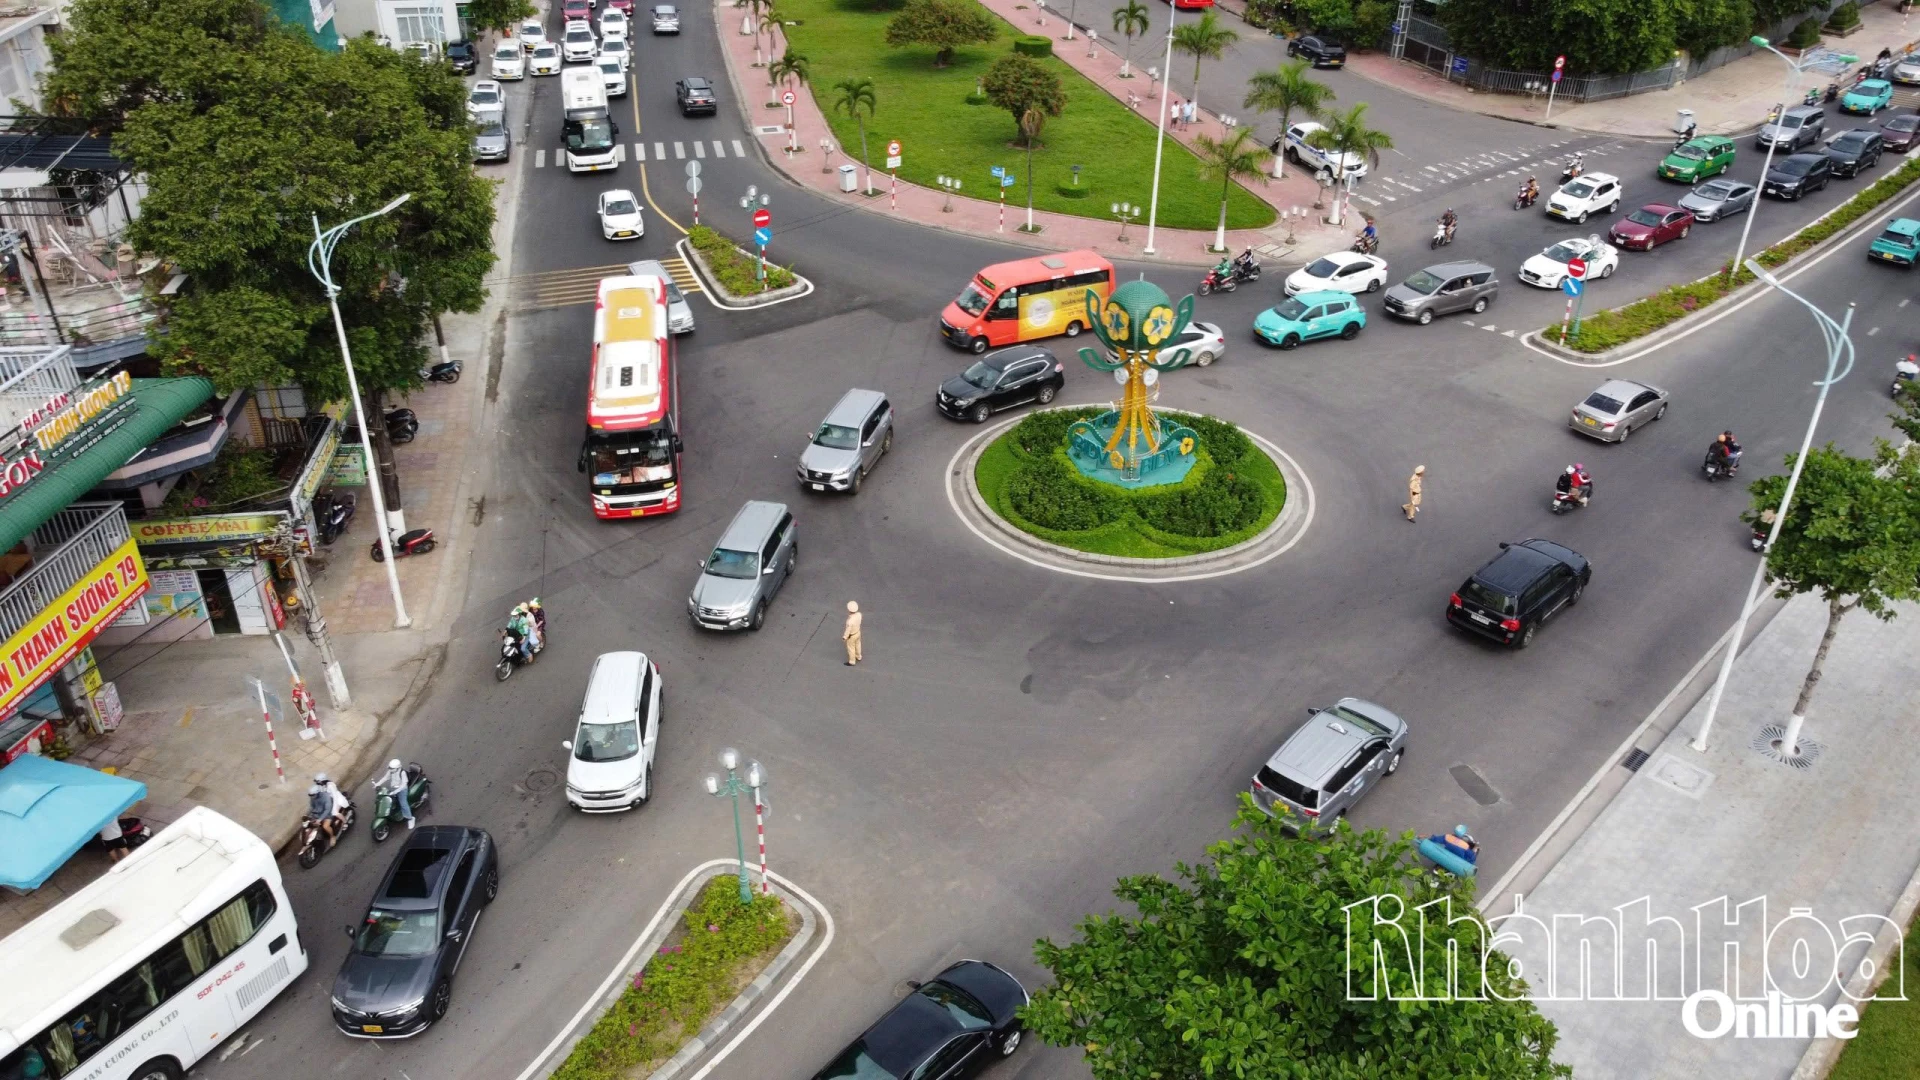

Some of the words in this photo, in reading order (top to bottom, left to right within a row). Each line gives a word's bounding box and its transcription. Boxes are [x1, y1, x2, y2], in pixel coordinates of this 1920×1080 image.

[112, 371, 131, 396] 79
[140, 522, 210, 536] COFFEE
[10, 614, 68, 678] THANH
[66, 572, 120, 632] SƯƠNG
[117, 555, 138, 588] 79
[104, 1039, 138, 1069] CUONG
